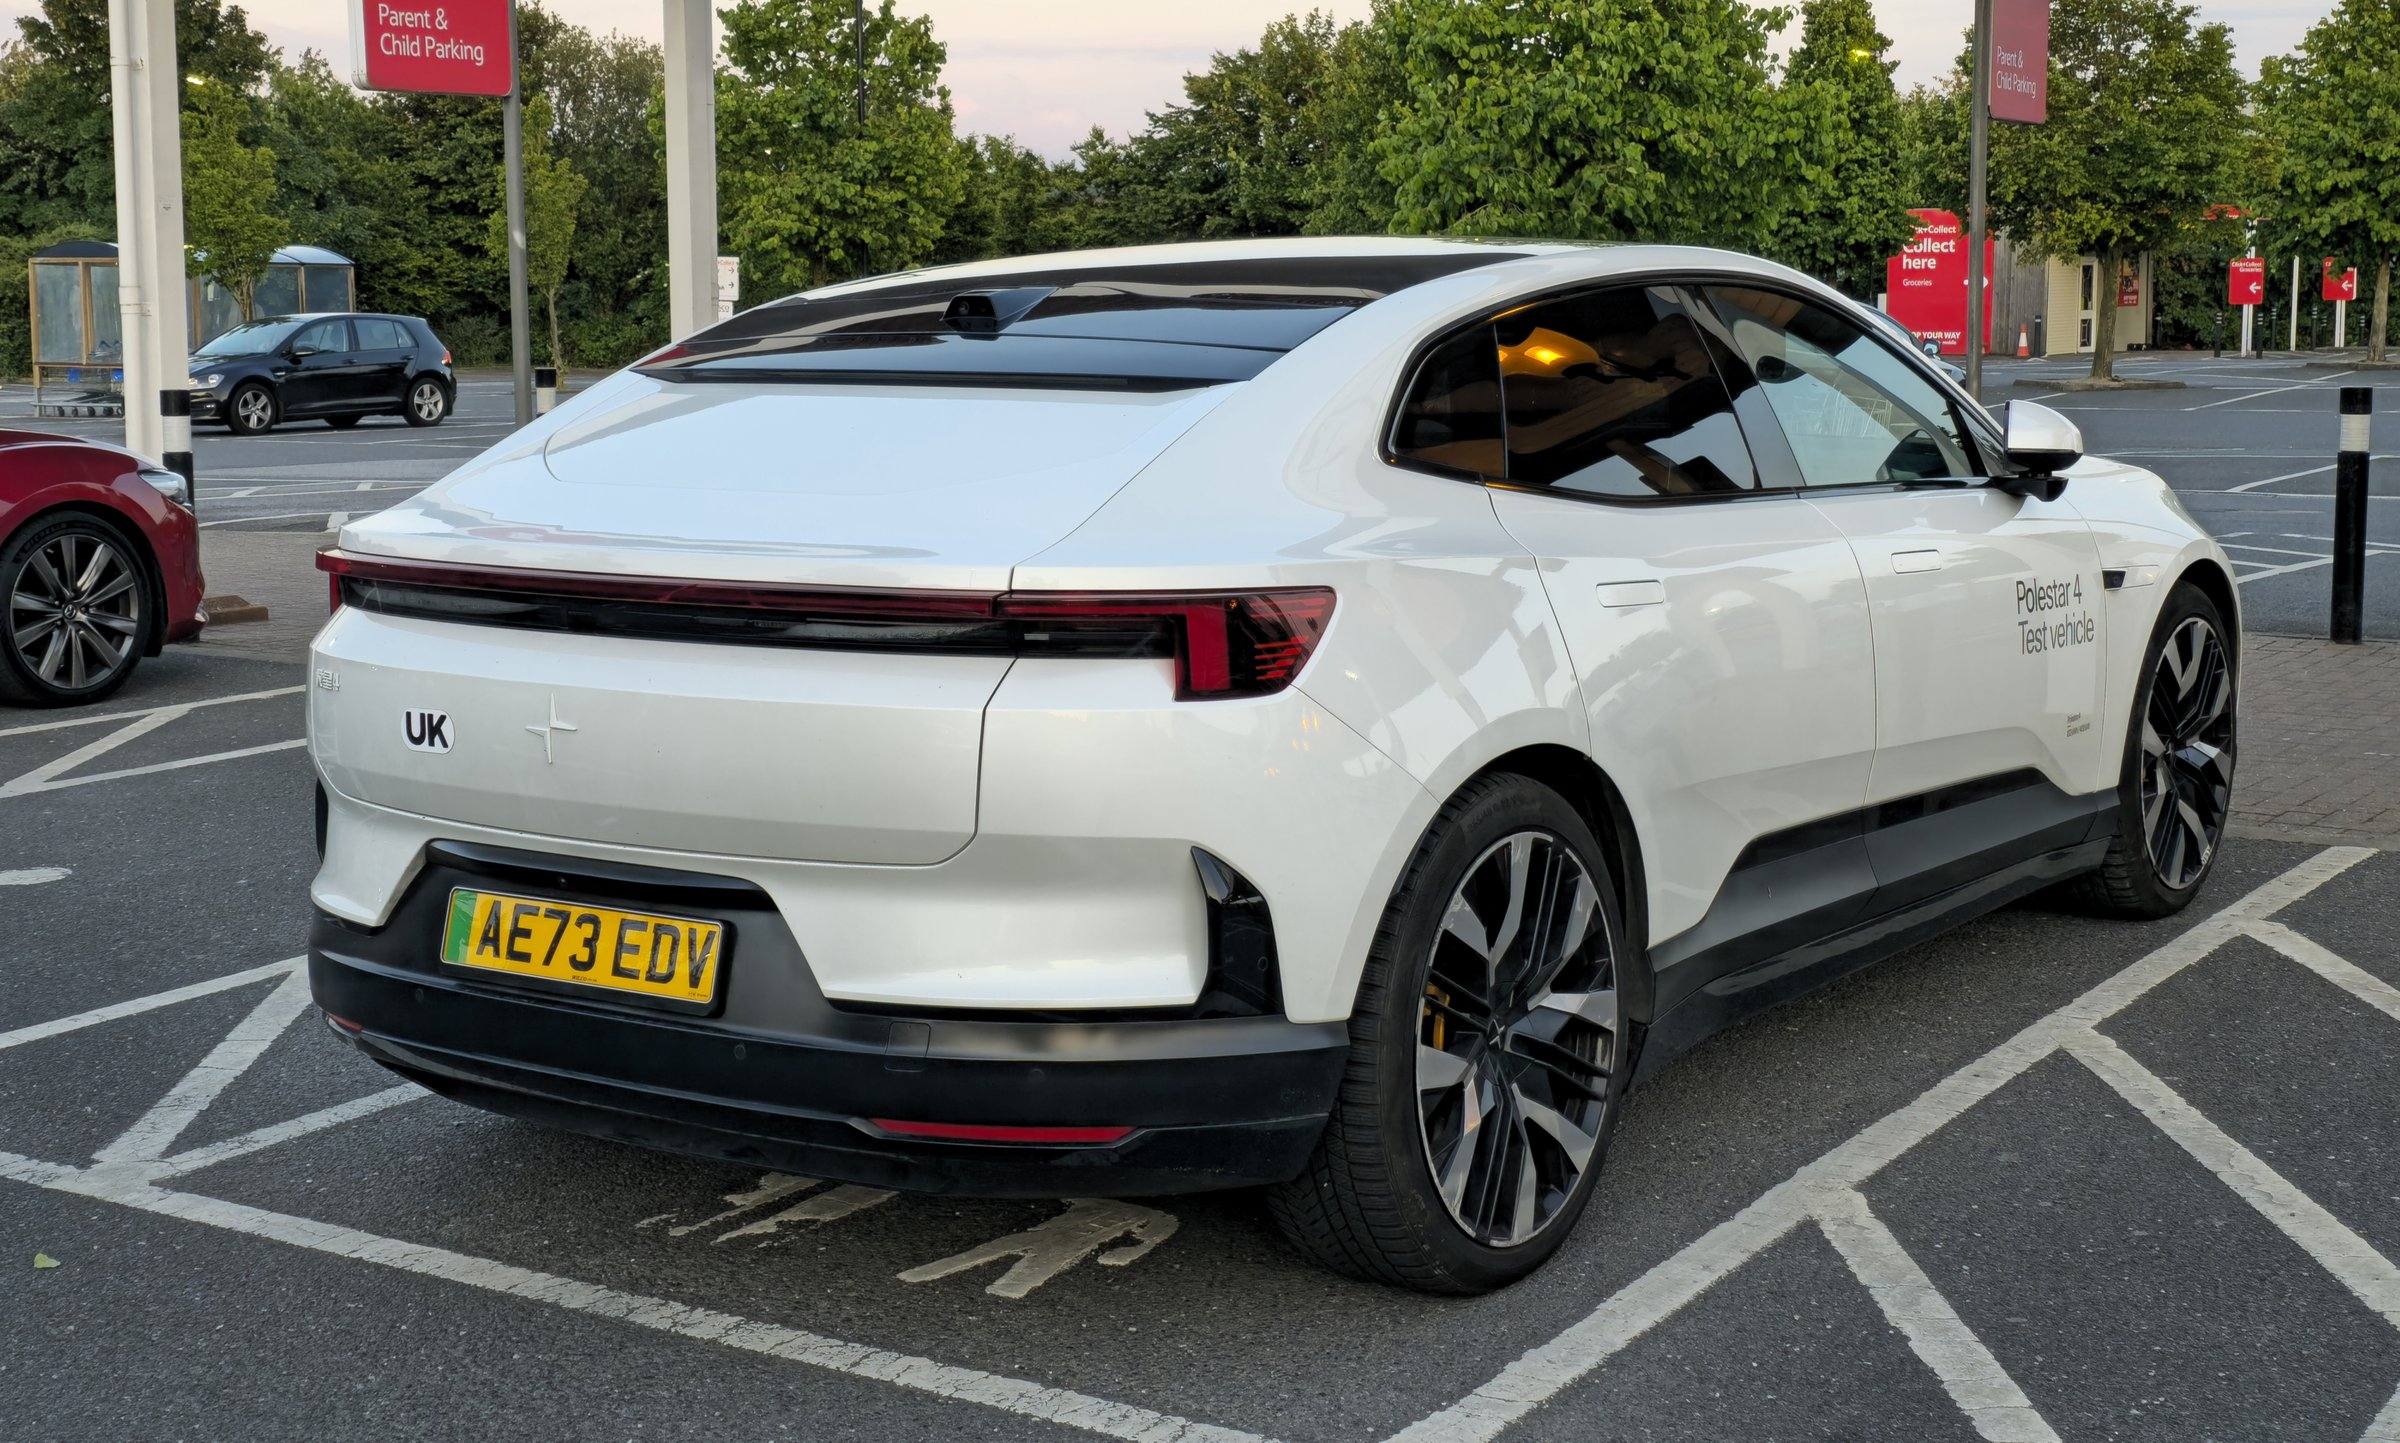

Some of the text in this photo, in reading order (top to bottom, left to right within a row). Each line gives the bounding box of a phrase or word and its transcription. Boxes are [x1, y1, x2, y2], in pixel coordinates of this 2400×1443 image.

[378, 3, 448, 30] Parent &
[380, 33, 484, 66] Child Parking
[1996, 46, 2024, 68] Parent &
[1996, 71, 2037, 99] Child Parking
[1903, 254, 1936, 269] here
[1903, 278, 1932, 286] Groceries
[1923, 331, 1943, 339] YOUR
[1944, 331, 1961, 339] WAY
[2016, 574, 2082, 614] Polestar 4
[2018, 611, 2094, 655] Test vehicle
[406, 711, 449, 749] UK
[476, 900, 717, 989] AE73 EDV
